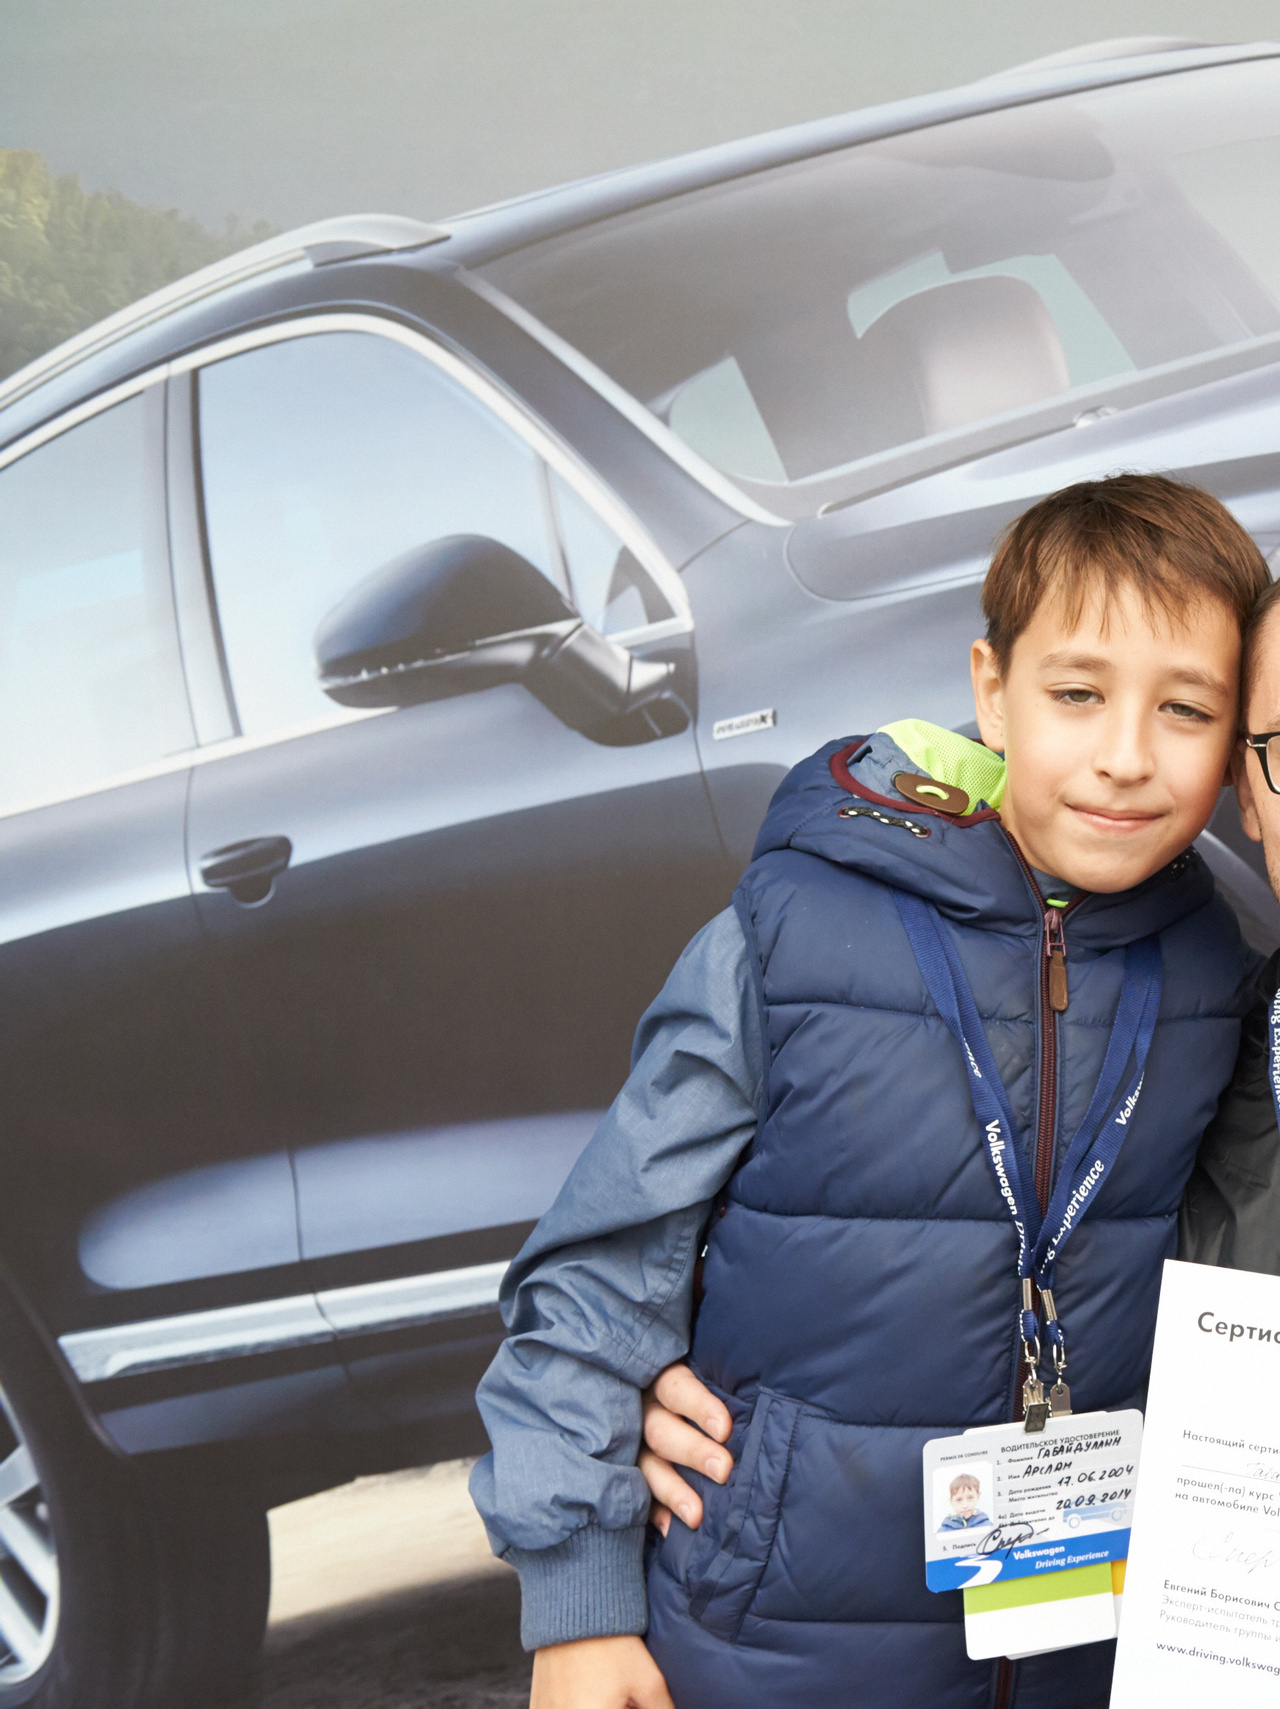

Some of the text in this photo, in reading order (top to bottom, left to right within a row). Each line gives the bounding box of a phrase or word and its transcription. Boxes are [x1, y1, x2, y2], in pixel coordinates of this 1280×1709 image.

[985, 1119, 1018, 1215] Volkswagen
[1000, 1430, 1120, 1453] ВОДИТЕЛЬСКОЕ УДОСТОВЕРЕНИЕ
[1182, 1429, 1245, 1449] Настоящий
[965, 1450, 988, 1458] CONDUIRE
[1022, 1459, 1073, 1479] АРСЛАН
[1176, 1477, 1246, 1498] прошел(-ла)
[1248, 1489, 1274, 1502] курс
[1174, 1492, 1190, 1501] на
[1191, 1494, 1259, 1513] автомобиле
[1013, 1545, 1065, 1561] Volkswagen
[1035, 1550, 1109, 1570] Driving Experience
[1163, 1579, 1207, 1597] Евгений
[1210, 1588, 1271, 1609] Борисович
[1161, 1594, 1268, 1625] Эксперт-испытатель
[1159, 1609, 1231, 1633] Руководитель
[1234, 1625, 1272, 1643] группы
